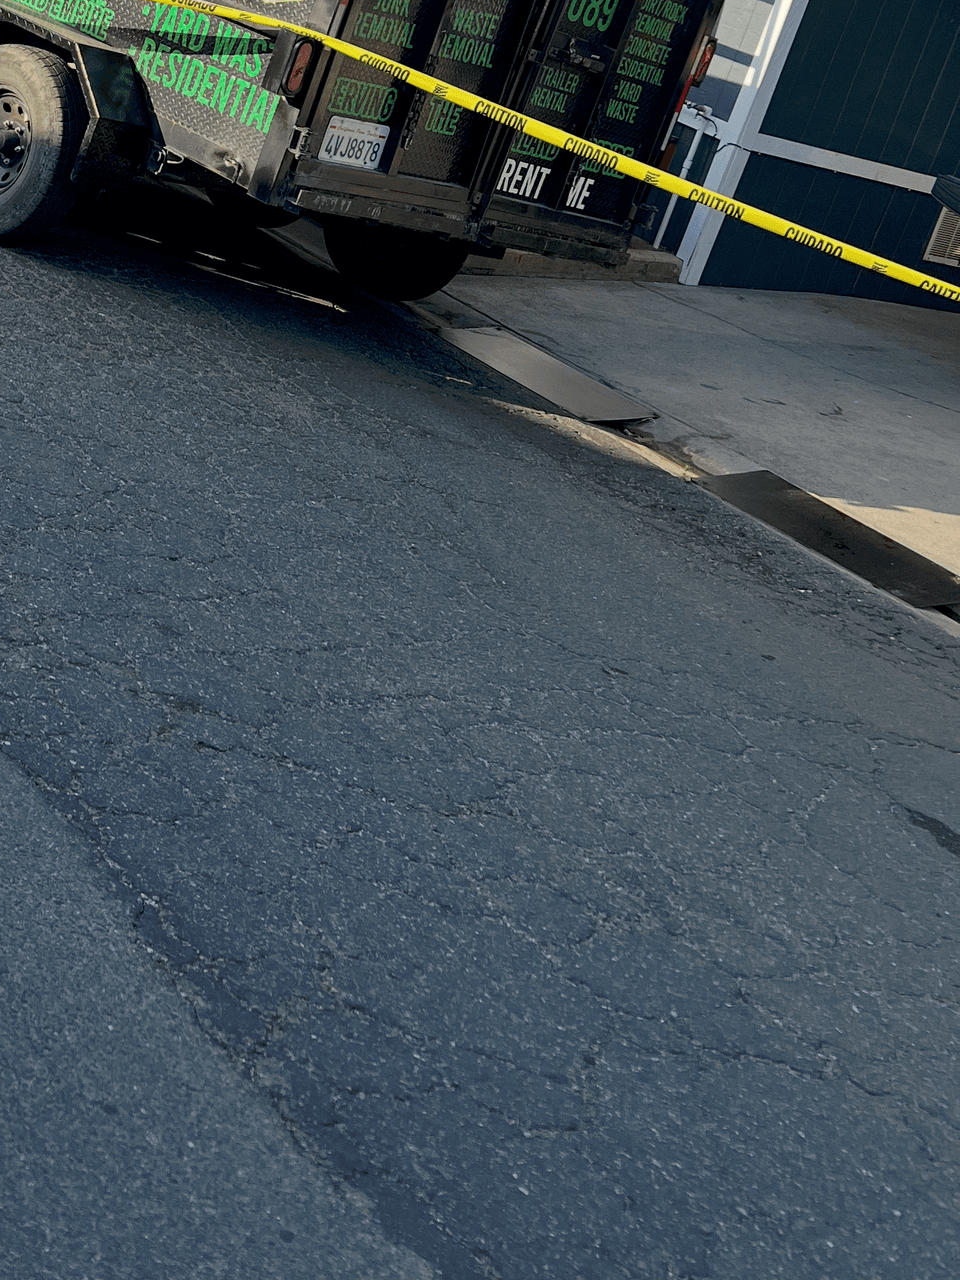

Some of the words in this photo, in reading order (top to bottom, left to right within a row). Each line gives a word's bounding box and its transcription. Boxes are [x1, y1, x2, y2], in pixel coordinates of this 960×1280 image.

[452, 7, 500, 39] WASTE
[150, 2, 210, 52] YARD
[212, 21, 274, 78] WAS
[542, 66, 580, 94] TRAILER
[617, 79, 642, 103] YARD
[531, 86, 571, 113] RENTAL
[606, 98, 640, 124] WASTE
[324, 133, 381, 162] 4VJ8878
[474, 100, 528, 131] CAUTION
[563, 137, 619, 169] CUIDADO
[689, 188, 745, 220] CAUTION
[784, 226, 844, 259] CUIDADO
[496, 158, 551, 199] RENT
